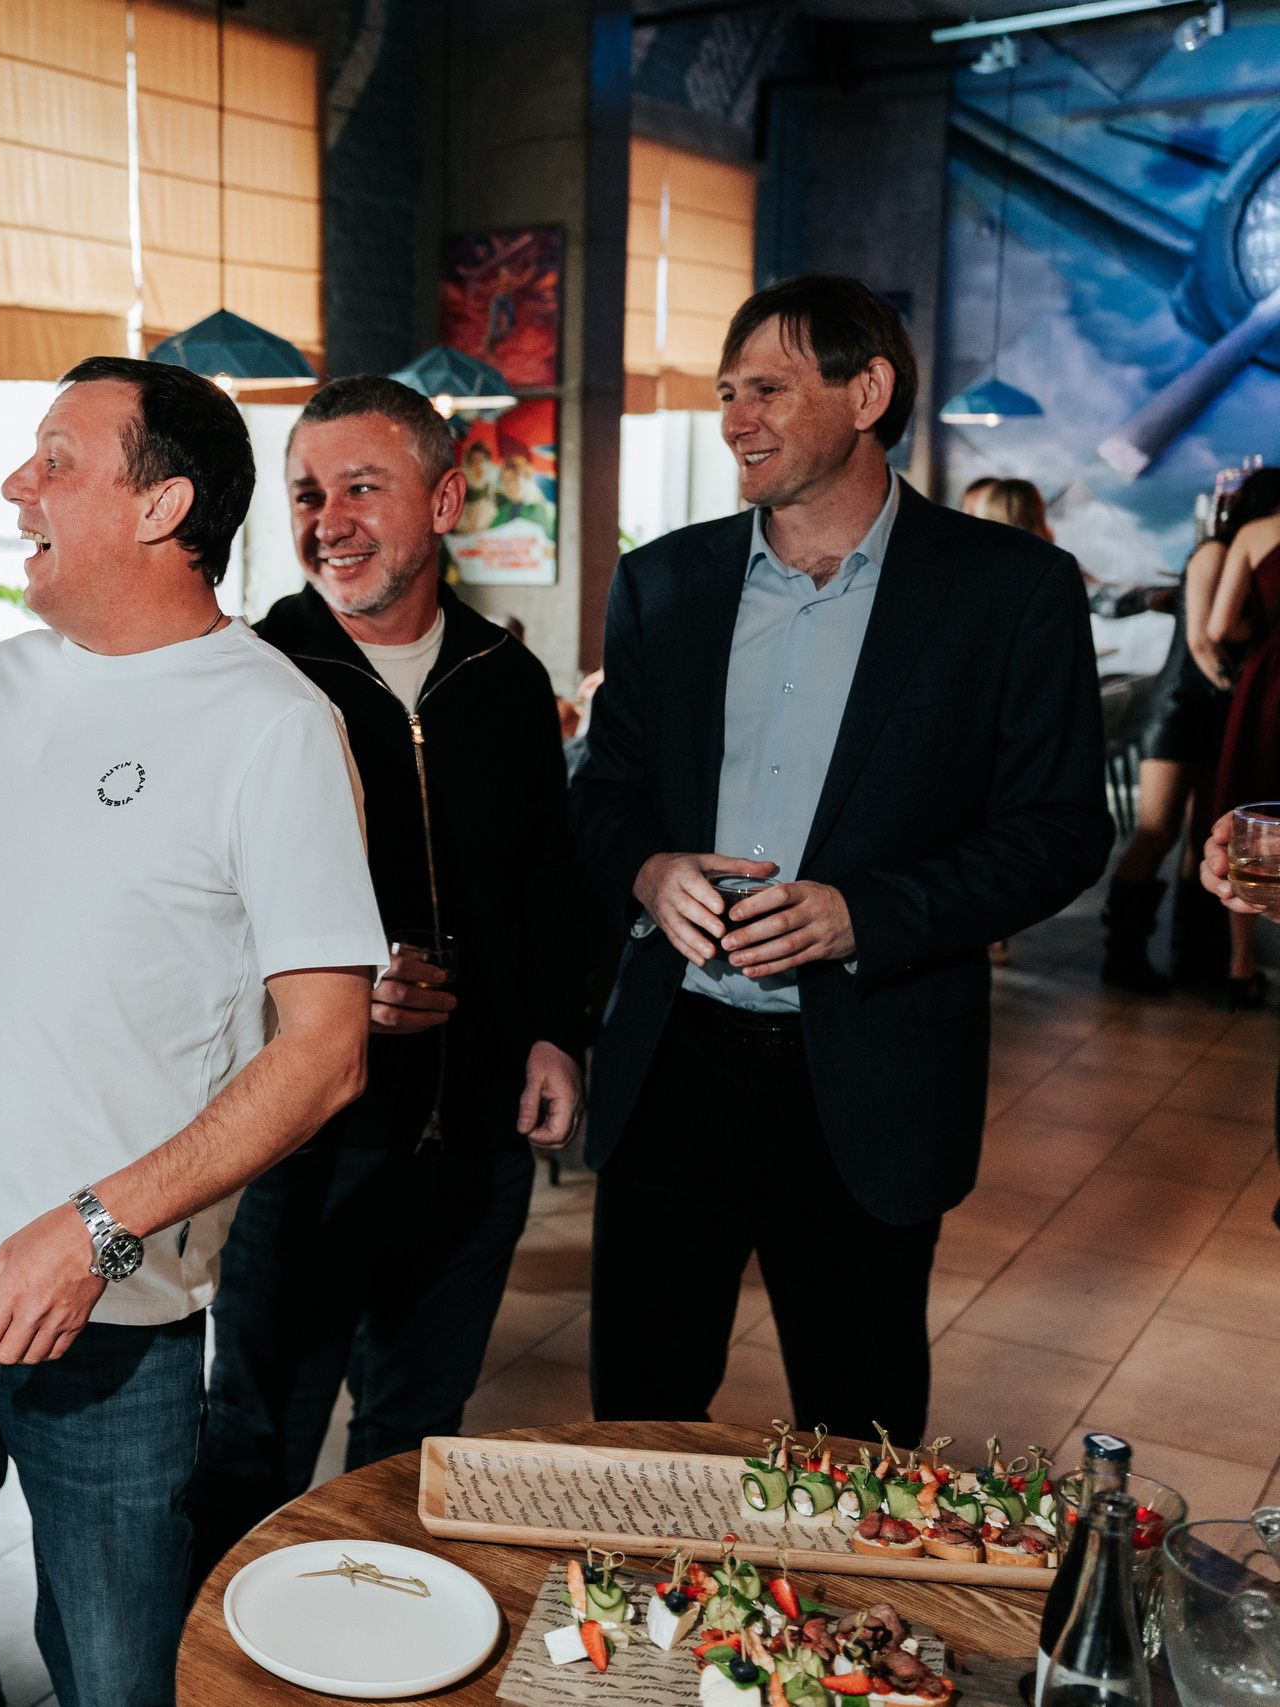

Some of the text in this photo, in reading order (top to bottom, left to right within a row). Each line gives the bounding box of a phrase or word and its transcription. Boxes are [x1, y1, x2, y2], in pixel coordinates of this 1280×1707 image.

[100, 761, 146, 793] PUTIN TEAM
[97, 787, 133, 807] RUSSIA
